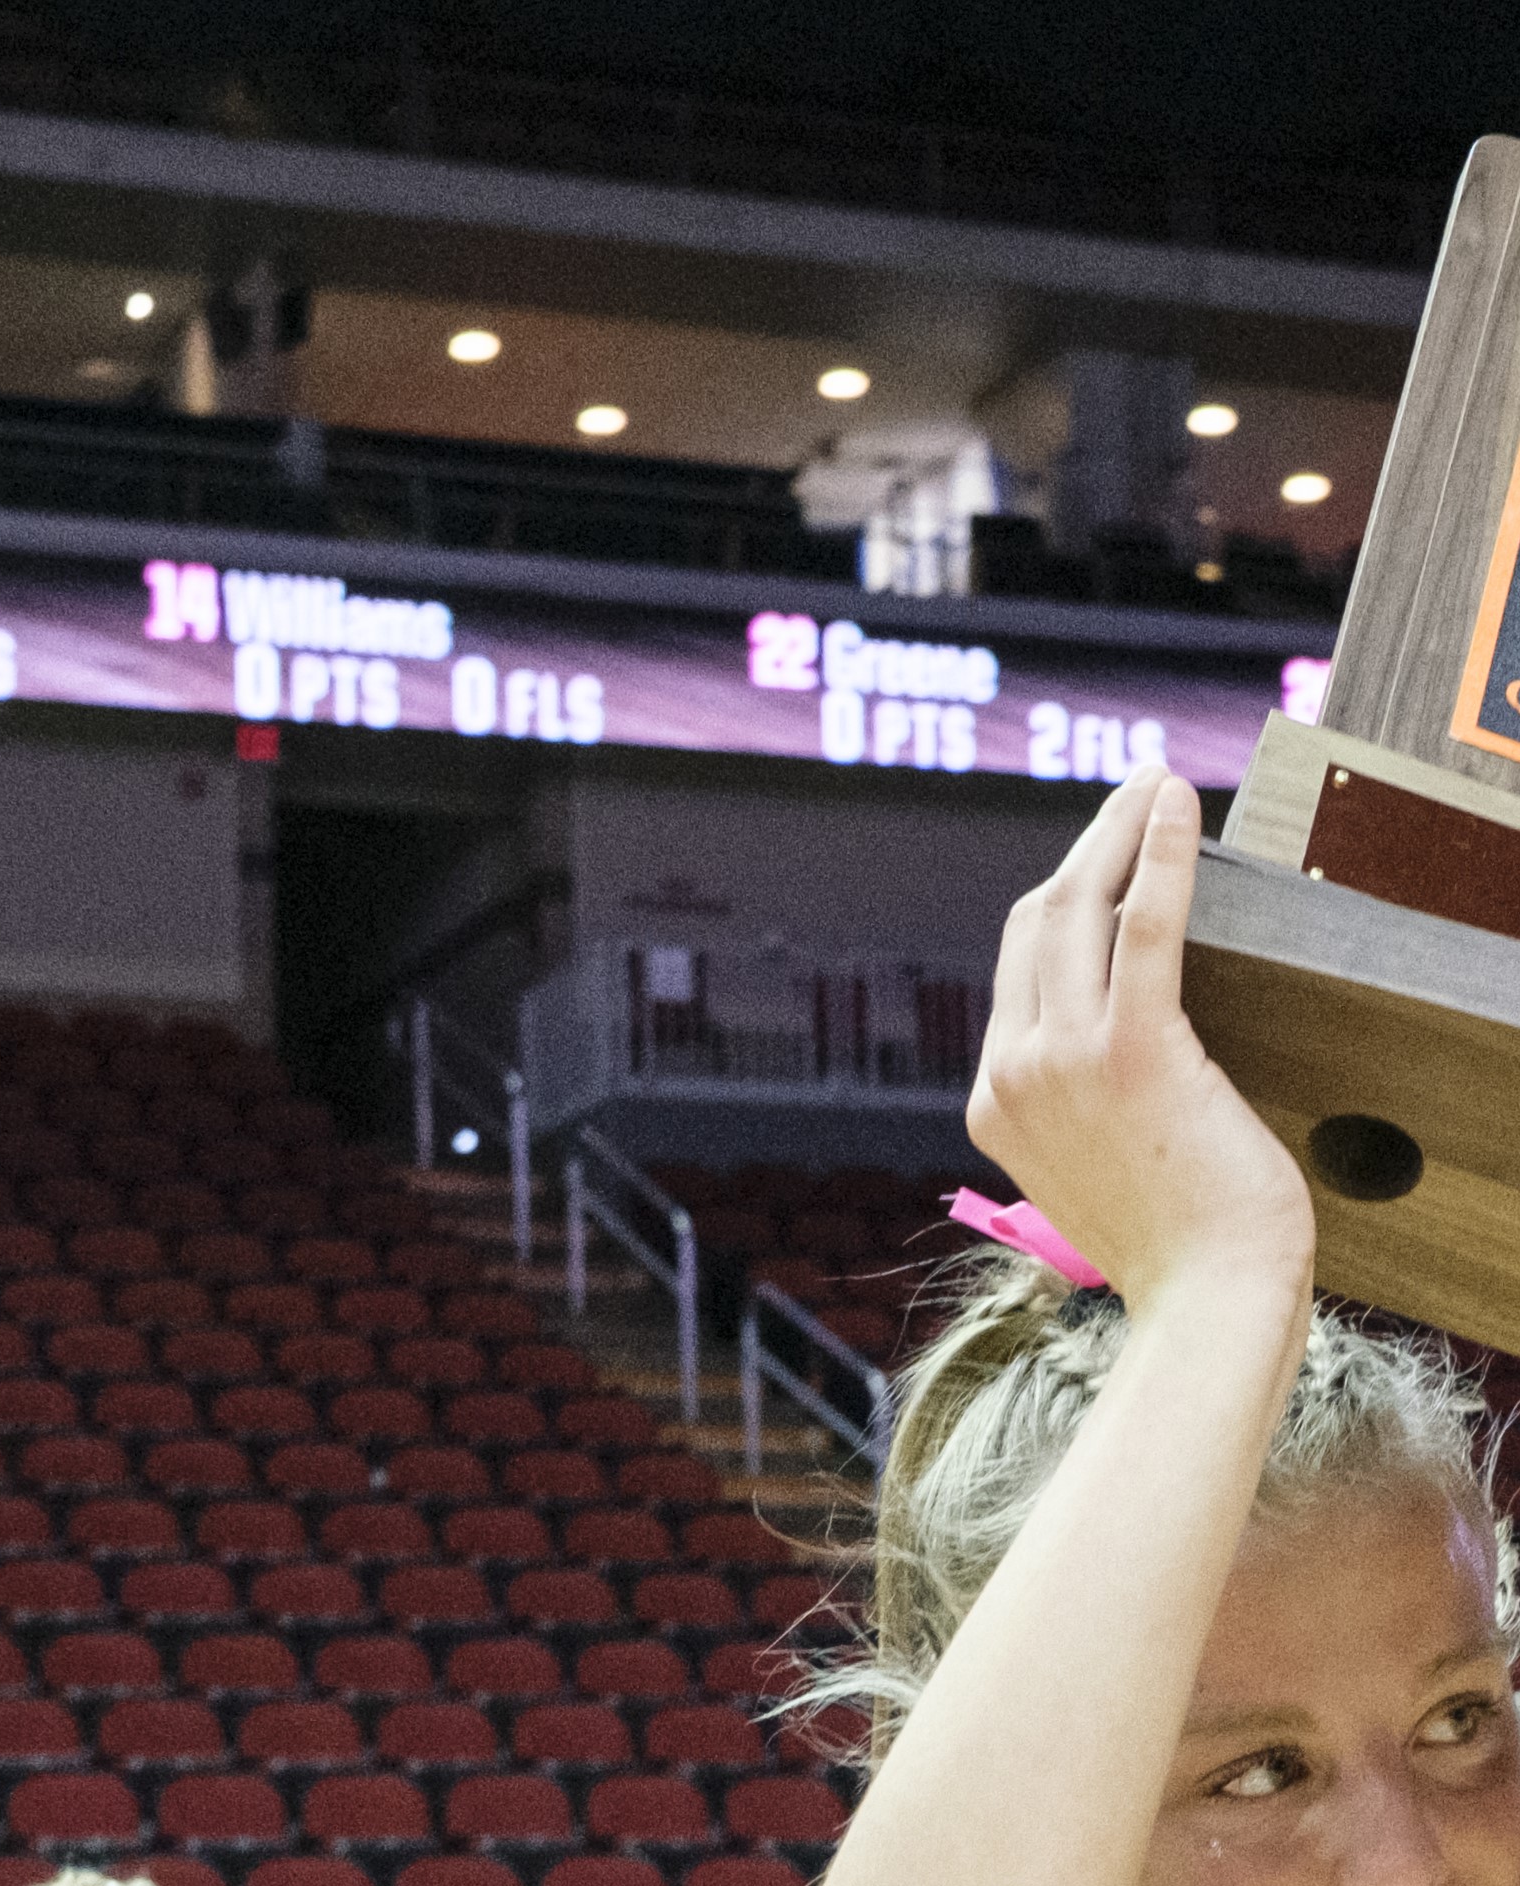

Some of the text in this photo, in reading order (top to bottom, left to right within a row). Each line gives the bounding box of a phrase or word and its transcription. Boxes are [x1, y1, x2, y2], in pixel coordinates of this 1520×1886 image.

[143, 559, 219, 643] 14
[233, 642, 604, 745] 0 PTS 0 FLS
[747, 610, 1000, 705] 22 Greene
[820, 687, 1168, 784] 0 PTS 2 FLS
